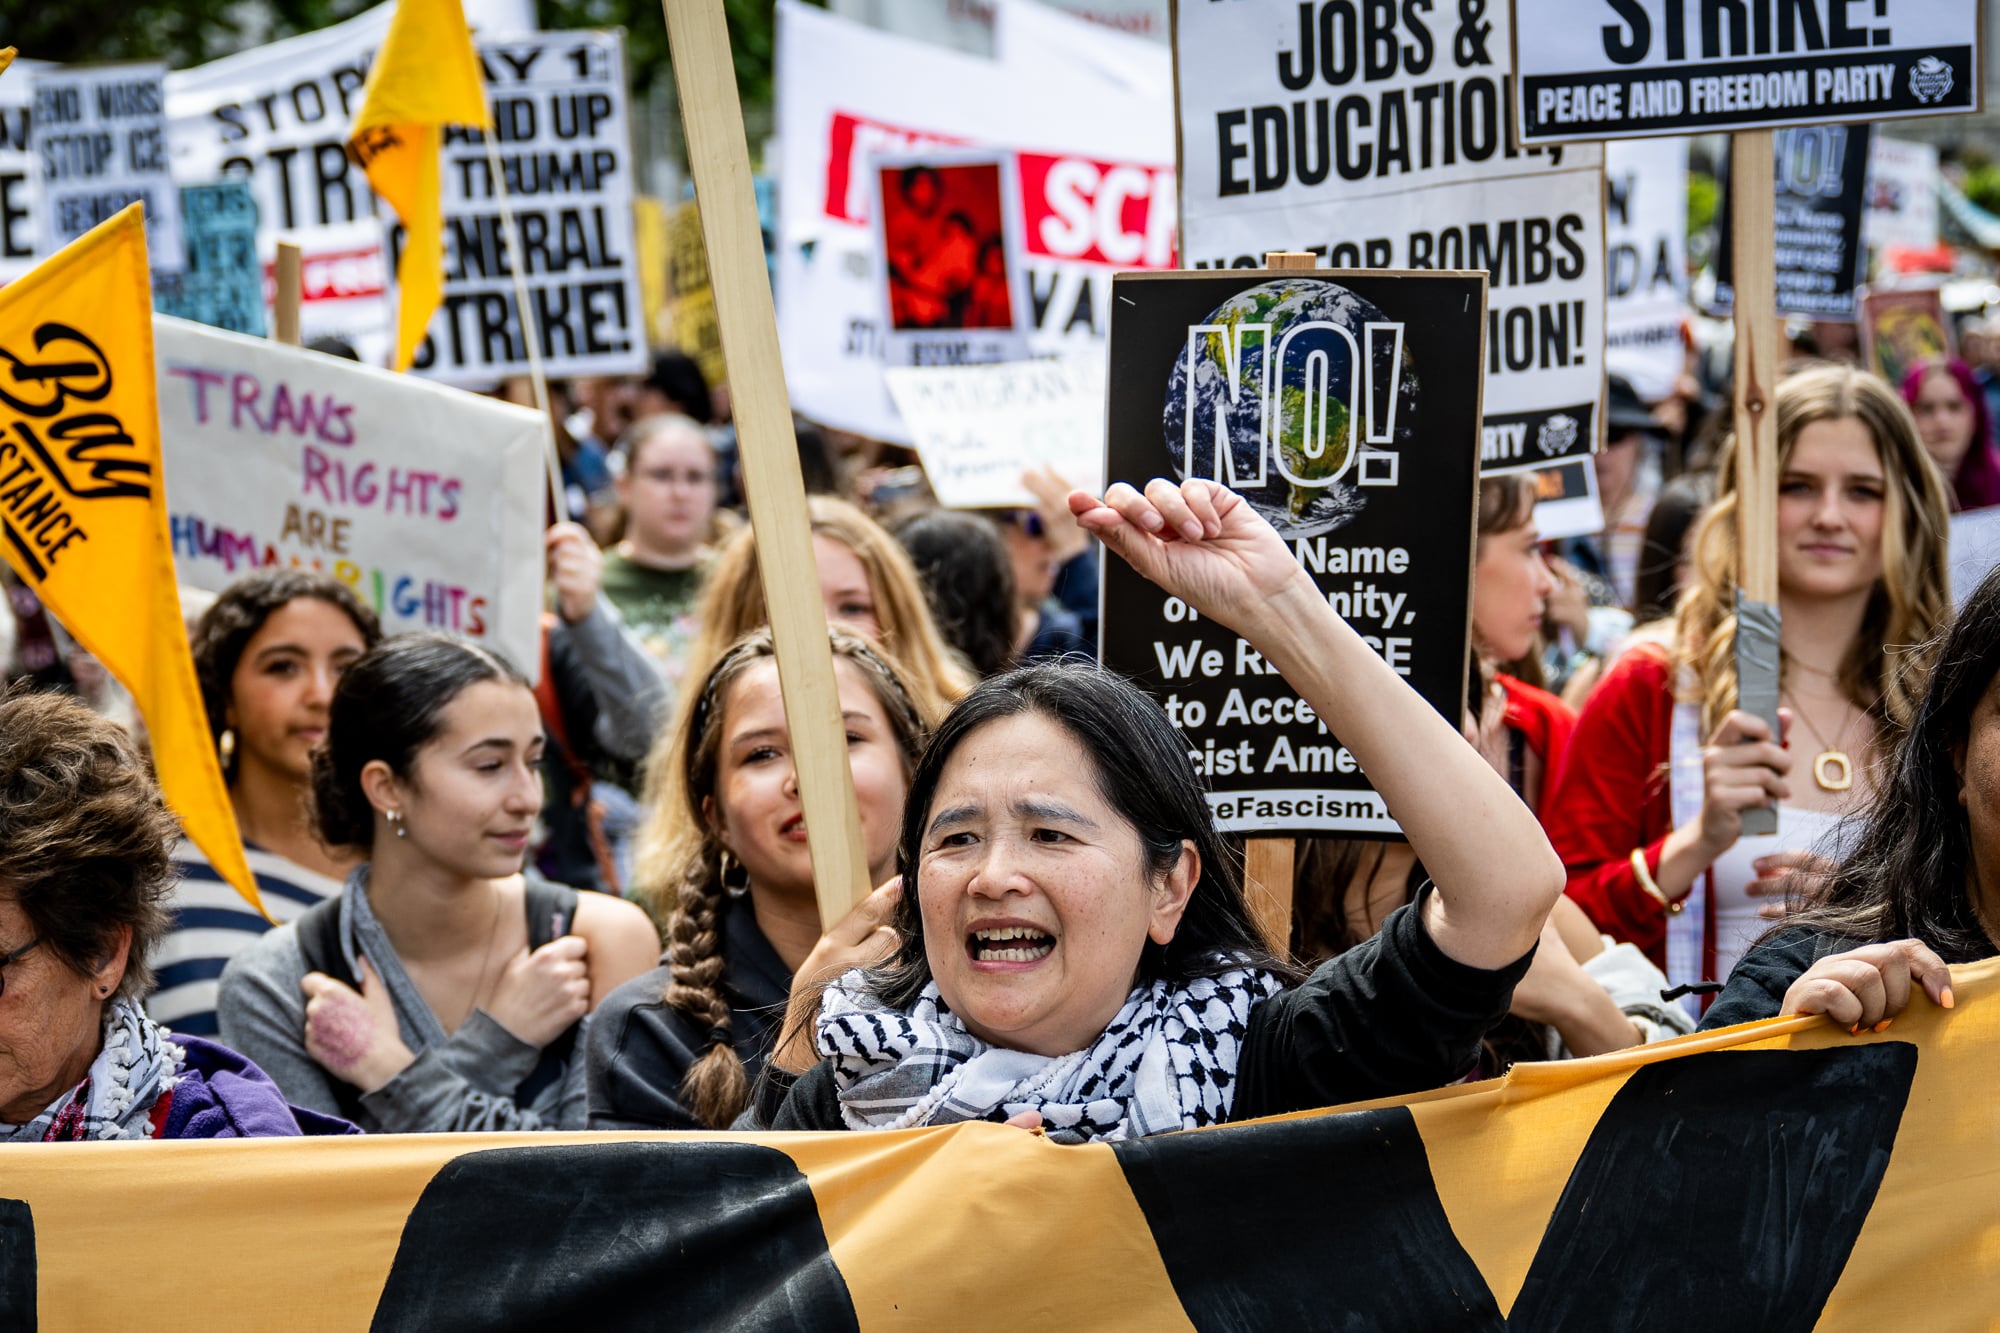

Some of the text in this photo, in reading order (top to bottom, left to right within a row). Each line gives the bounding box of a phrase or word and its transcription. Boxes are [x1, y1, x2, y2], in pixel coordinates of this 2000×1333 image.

[1277, 0, 1493, 91] JOBS &
[551, 93, 613, 140] UP
[1537, 83, 1622, 125] PEACE
[1629, 78, 1684, 119] AND
[1690, 69, 1808, 114] FREEDOM
[1816, 63, 1896, 103] PARTY
[390, 207, 622, 283] NERAL
[1409, 214, 1585, 287] BOMBS
[166, 359, 356, 446] TRANS
[1184, 320, 1405, 488] NO!
[0, 428, 88, 566] STANCE
[303, 445, 464, 522] RIGHTS
[170, 514, 322, 573] HUMA
[280, 501, 352, 555] ARE
[1296, 537, 1410, 574] Name
[1153, 639, 1224, 679] We
[1164, 693, 1207, 729] to
[1263, 735, 1366, 774] Ame
